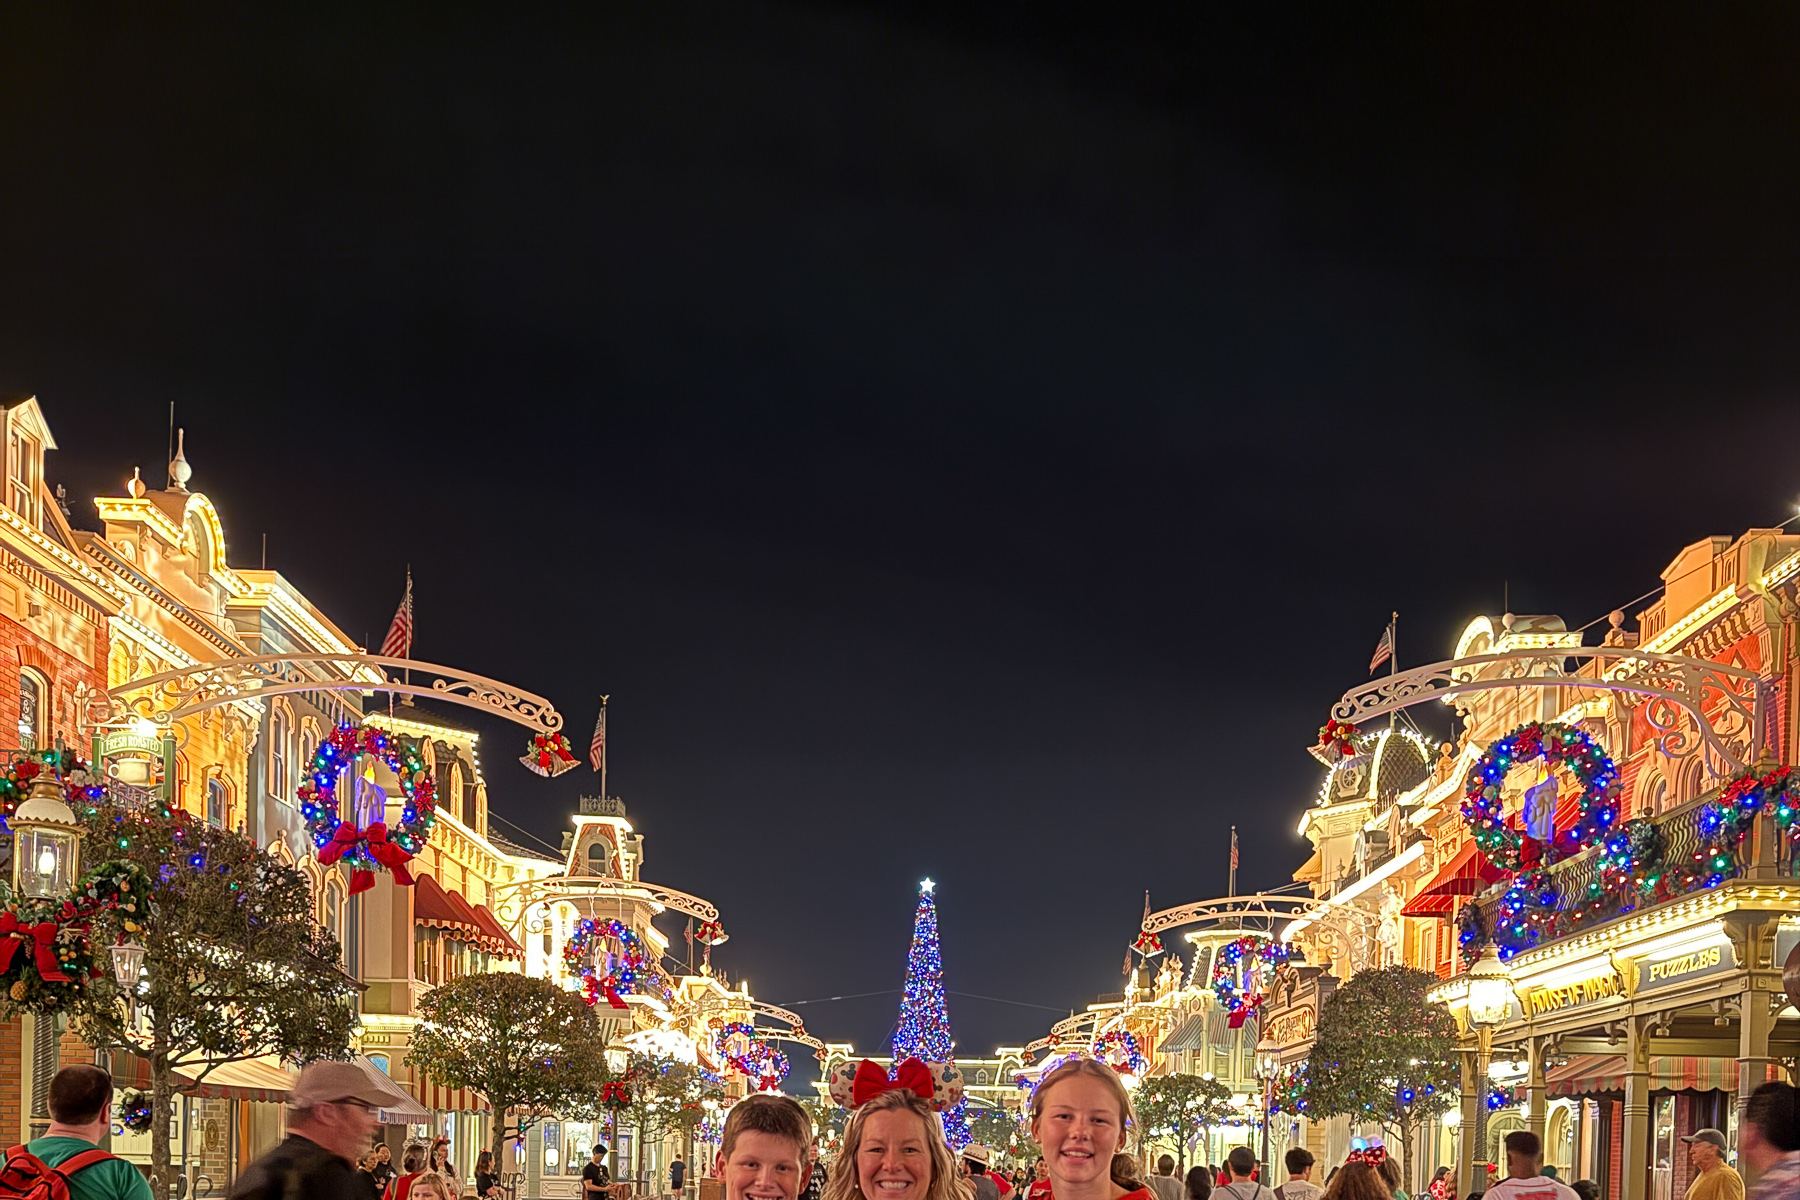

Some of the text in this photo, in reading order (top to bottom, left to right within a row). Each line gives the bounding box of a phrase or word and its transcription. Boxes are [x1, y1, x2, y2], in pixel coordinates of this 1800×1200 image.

[106, 735, 159, 752] FRESH ROASTED
[1649, 947, 1720, 982] PUZZLES
[1530, 988, 1568, 1015] HOUSE
[1568, 983, 1583, 1006] OF
[1583, 973, 1620, 1003] MAGIC
